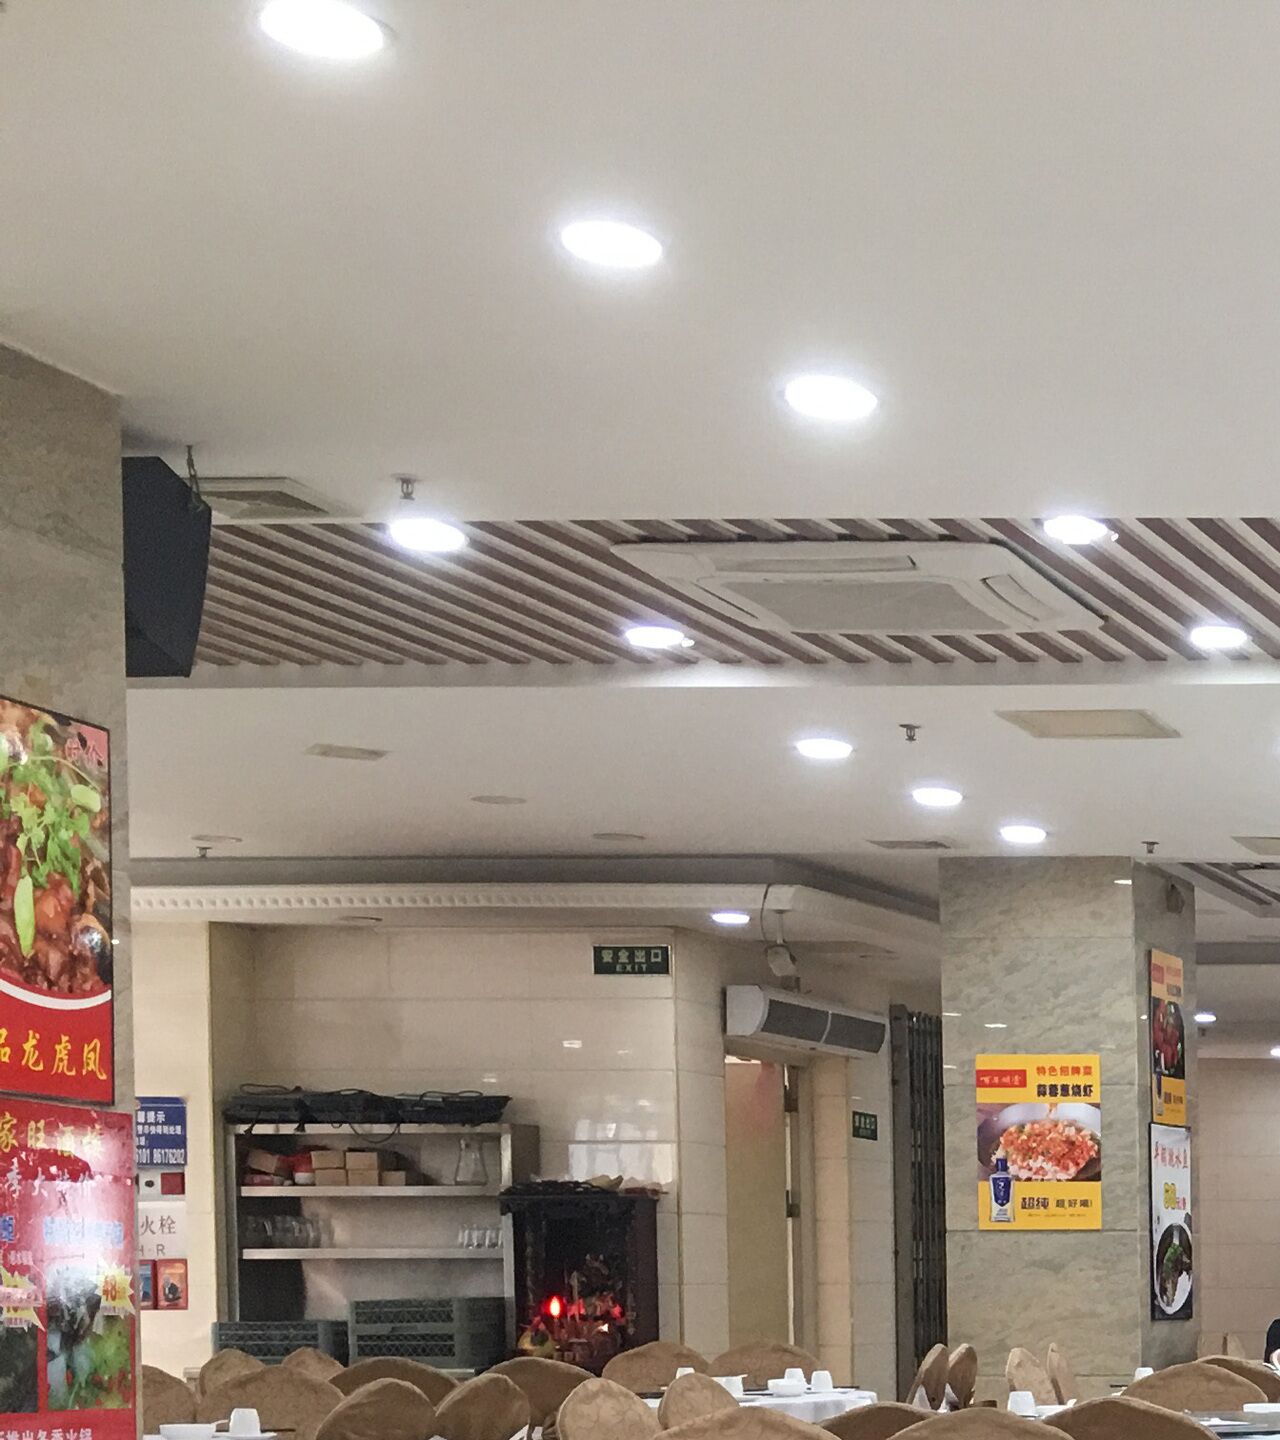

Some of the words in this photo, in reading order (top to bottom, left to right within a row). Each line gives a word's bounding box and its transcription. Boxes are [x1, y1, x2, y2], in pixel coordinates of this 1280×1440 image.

[601, 949, 662, 963] 安全出口
[616, 964, 647, 972] EXIT
[1036, 1066, 1092, 1076] 特色招牌菜
